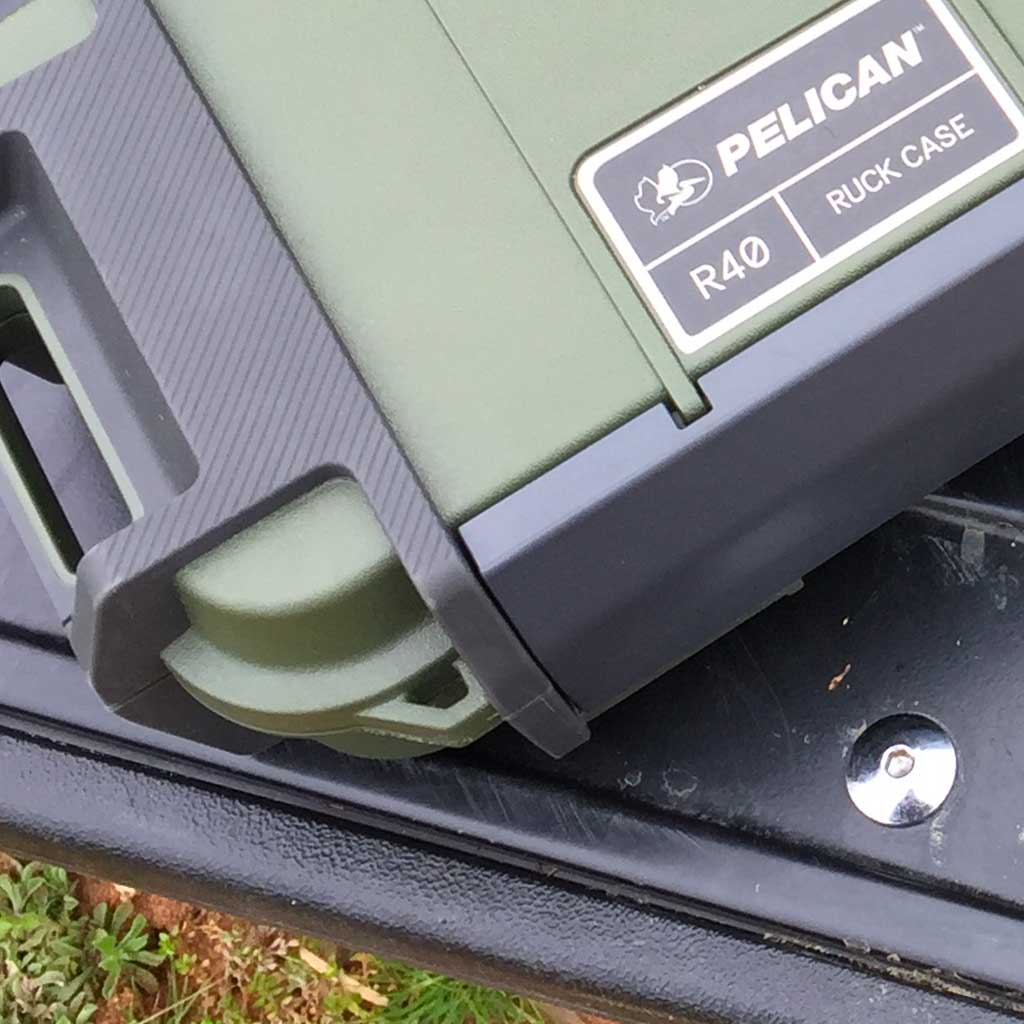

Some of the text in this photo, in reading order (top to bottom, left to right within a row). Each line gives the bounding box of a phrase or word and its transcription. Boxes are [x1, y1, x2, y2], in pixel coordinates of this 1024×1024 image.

[716, 30, 923, 177] PELICAN
[826, 113, 975, 215] RUCK CASE
[689, 236, 771, 300] R40
